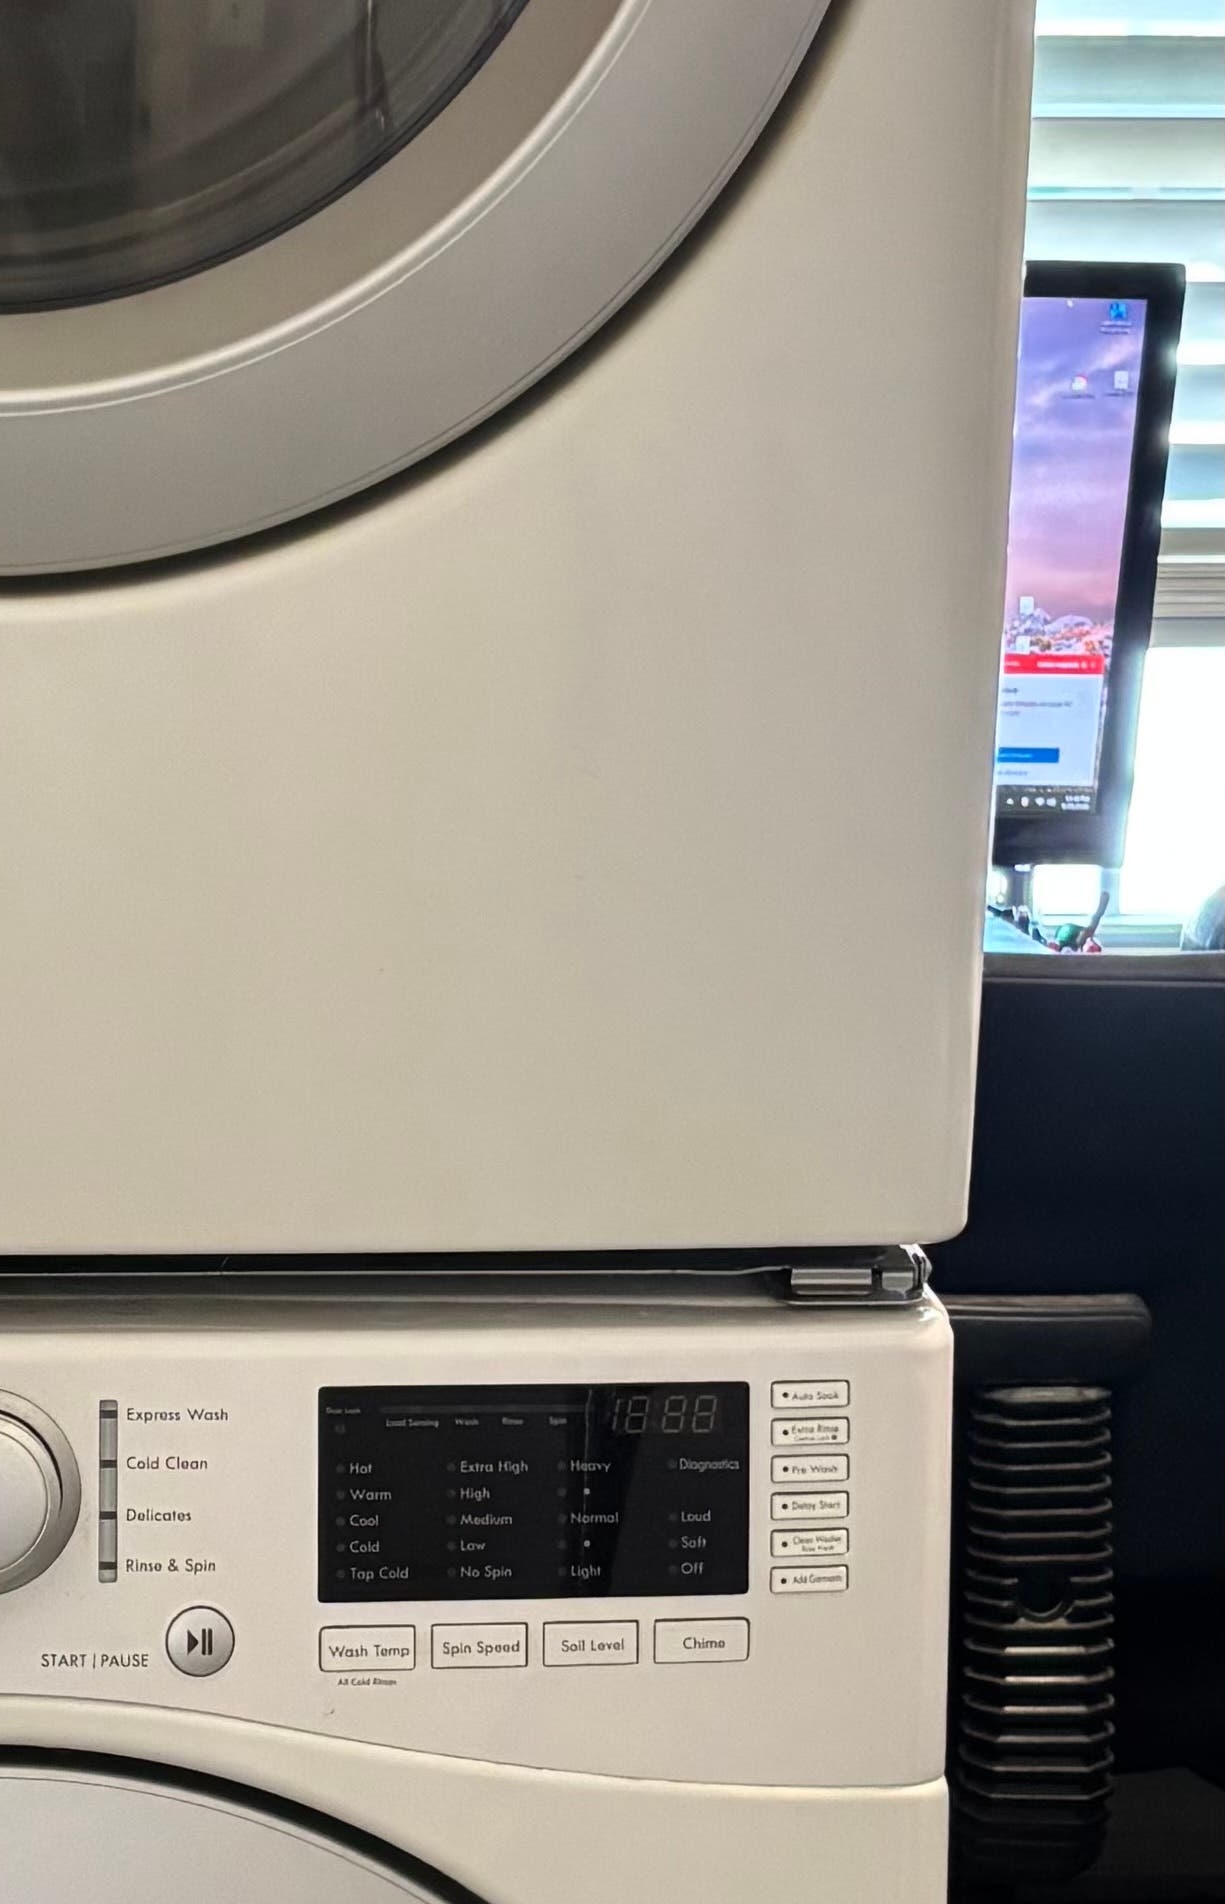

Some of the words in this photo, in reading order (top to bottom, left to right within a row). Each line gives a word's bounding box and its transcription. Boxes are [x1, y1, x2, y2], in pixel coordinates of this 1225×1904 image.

[127, 1408, 180, 1423] Express
[188, 1409, 228, 1420] Wash
[127, 1457, 159, 1469] Cold
[166, 1456, 207, 1469] Clean
[350, 1463, 372, 1473] Hot
[461, 1461, 493, 1472] Extra
[499, 1461, 528, 1474] High
[571, 1460, 610, 1472] Heavy
[680, 1458, 739, 1472] Diagnostics
[792, 1466, 806, 1474] Pre
[350, 1489, 391, 1500] Warm
[461, 1488, 490, 1501] High
[792, 1502, 816, 1511] Delay
[819, 1501, 840, 1509] Start
[127, 1509, 191, 1521] Delicates
[350, 1515, 378, 1526] Cool
[461, 1514, 512, 1525] Medium
[571, 1508, 618, 1523] Normal
[682, 1510, 711, 1522] Loud
[350, 1541, 379, 1552] Cold
[461, 1540, 485, 1551] Low
[682, 1536, 706, 1548] Soft
[126, 1559, 162, 1572] Rinse
[168, 1559, 178, 1572] &
[185, 1559, 215, 1575] Spin
[461, 1566, 480, 1577] No
[485, 1565, 512, 1580] Spin
[571, 1565, 600, 1579] Light
[681, 1562, 703, 1574] Off
[351, 1568, 374, 1581] Tap
[379, 1567, 408, 1579] Cold
[793, 1574, 807, 1583] Add
[443, 1642, 471, 1657] Spin
[477, 1640, 519, 1656] Speed
[562, 1640, 585, 1652] Soil
[591, 1638, 624, 1651] Level
[683, 1637, 725, 1649] Chime
[329, 1645, 368, 1657] Wash
[374, 1645, 409, 1657] Temp
[41, 1654, 86, 1667] START
[101, 1654, 148, 1667] PAUSE
